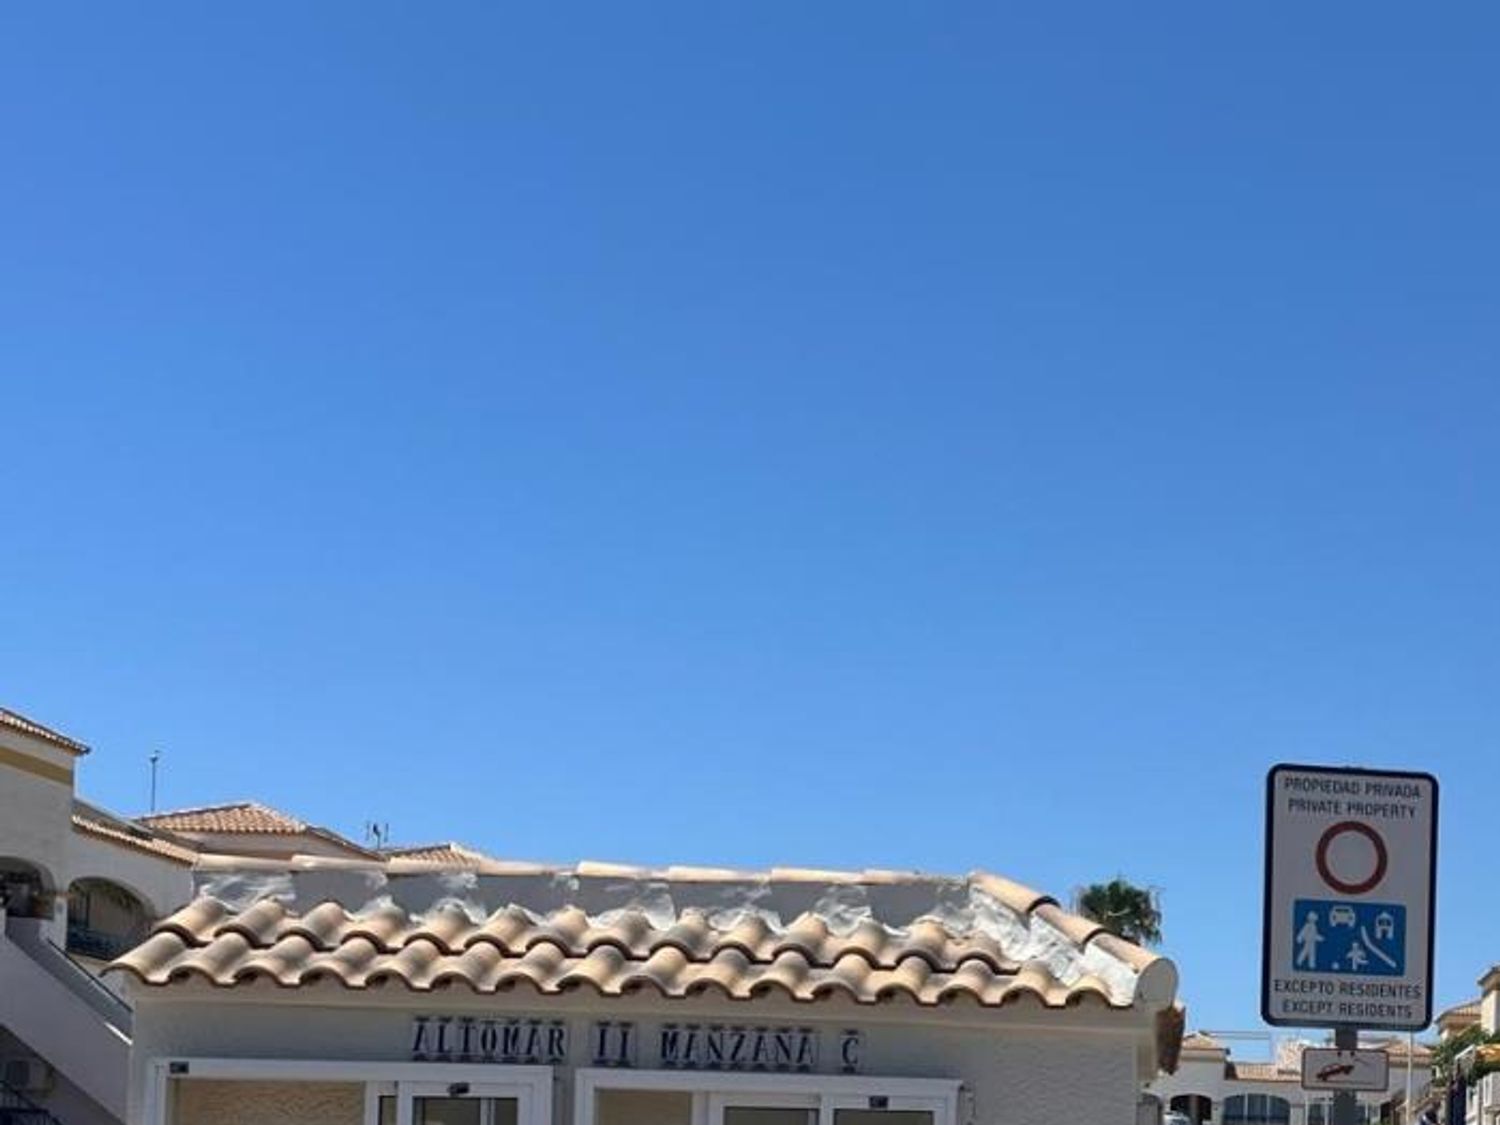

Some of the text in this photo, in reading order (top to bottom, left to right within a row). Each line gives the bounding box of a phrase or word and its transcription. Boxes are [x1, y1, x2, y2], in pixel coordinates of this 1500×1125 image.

[1284, 777, 1421, 798] PROPIEDAD PRIVADA
[1288, 798, 1417, 819] PRIVATE PROPERTY
[1274, 979, 1422, 999] EXCEPTO RESIDENTES
[1282, 999, 1413, 1019] EXCEPT RESIDENTS
[412, 1021, 566, 1059] ALTOMAR
[660, 1028, 815, 1066] MANZANA
[840, 1034, 861, 1068] C
